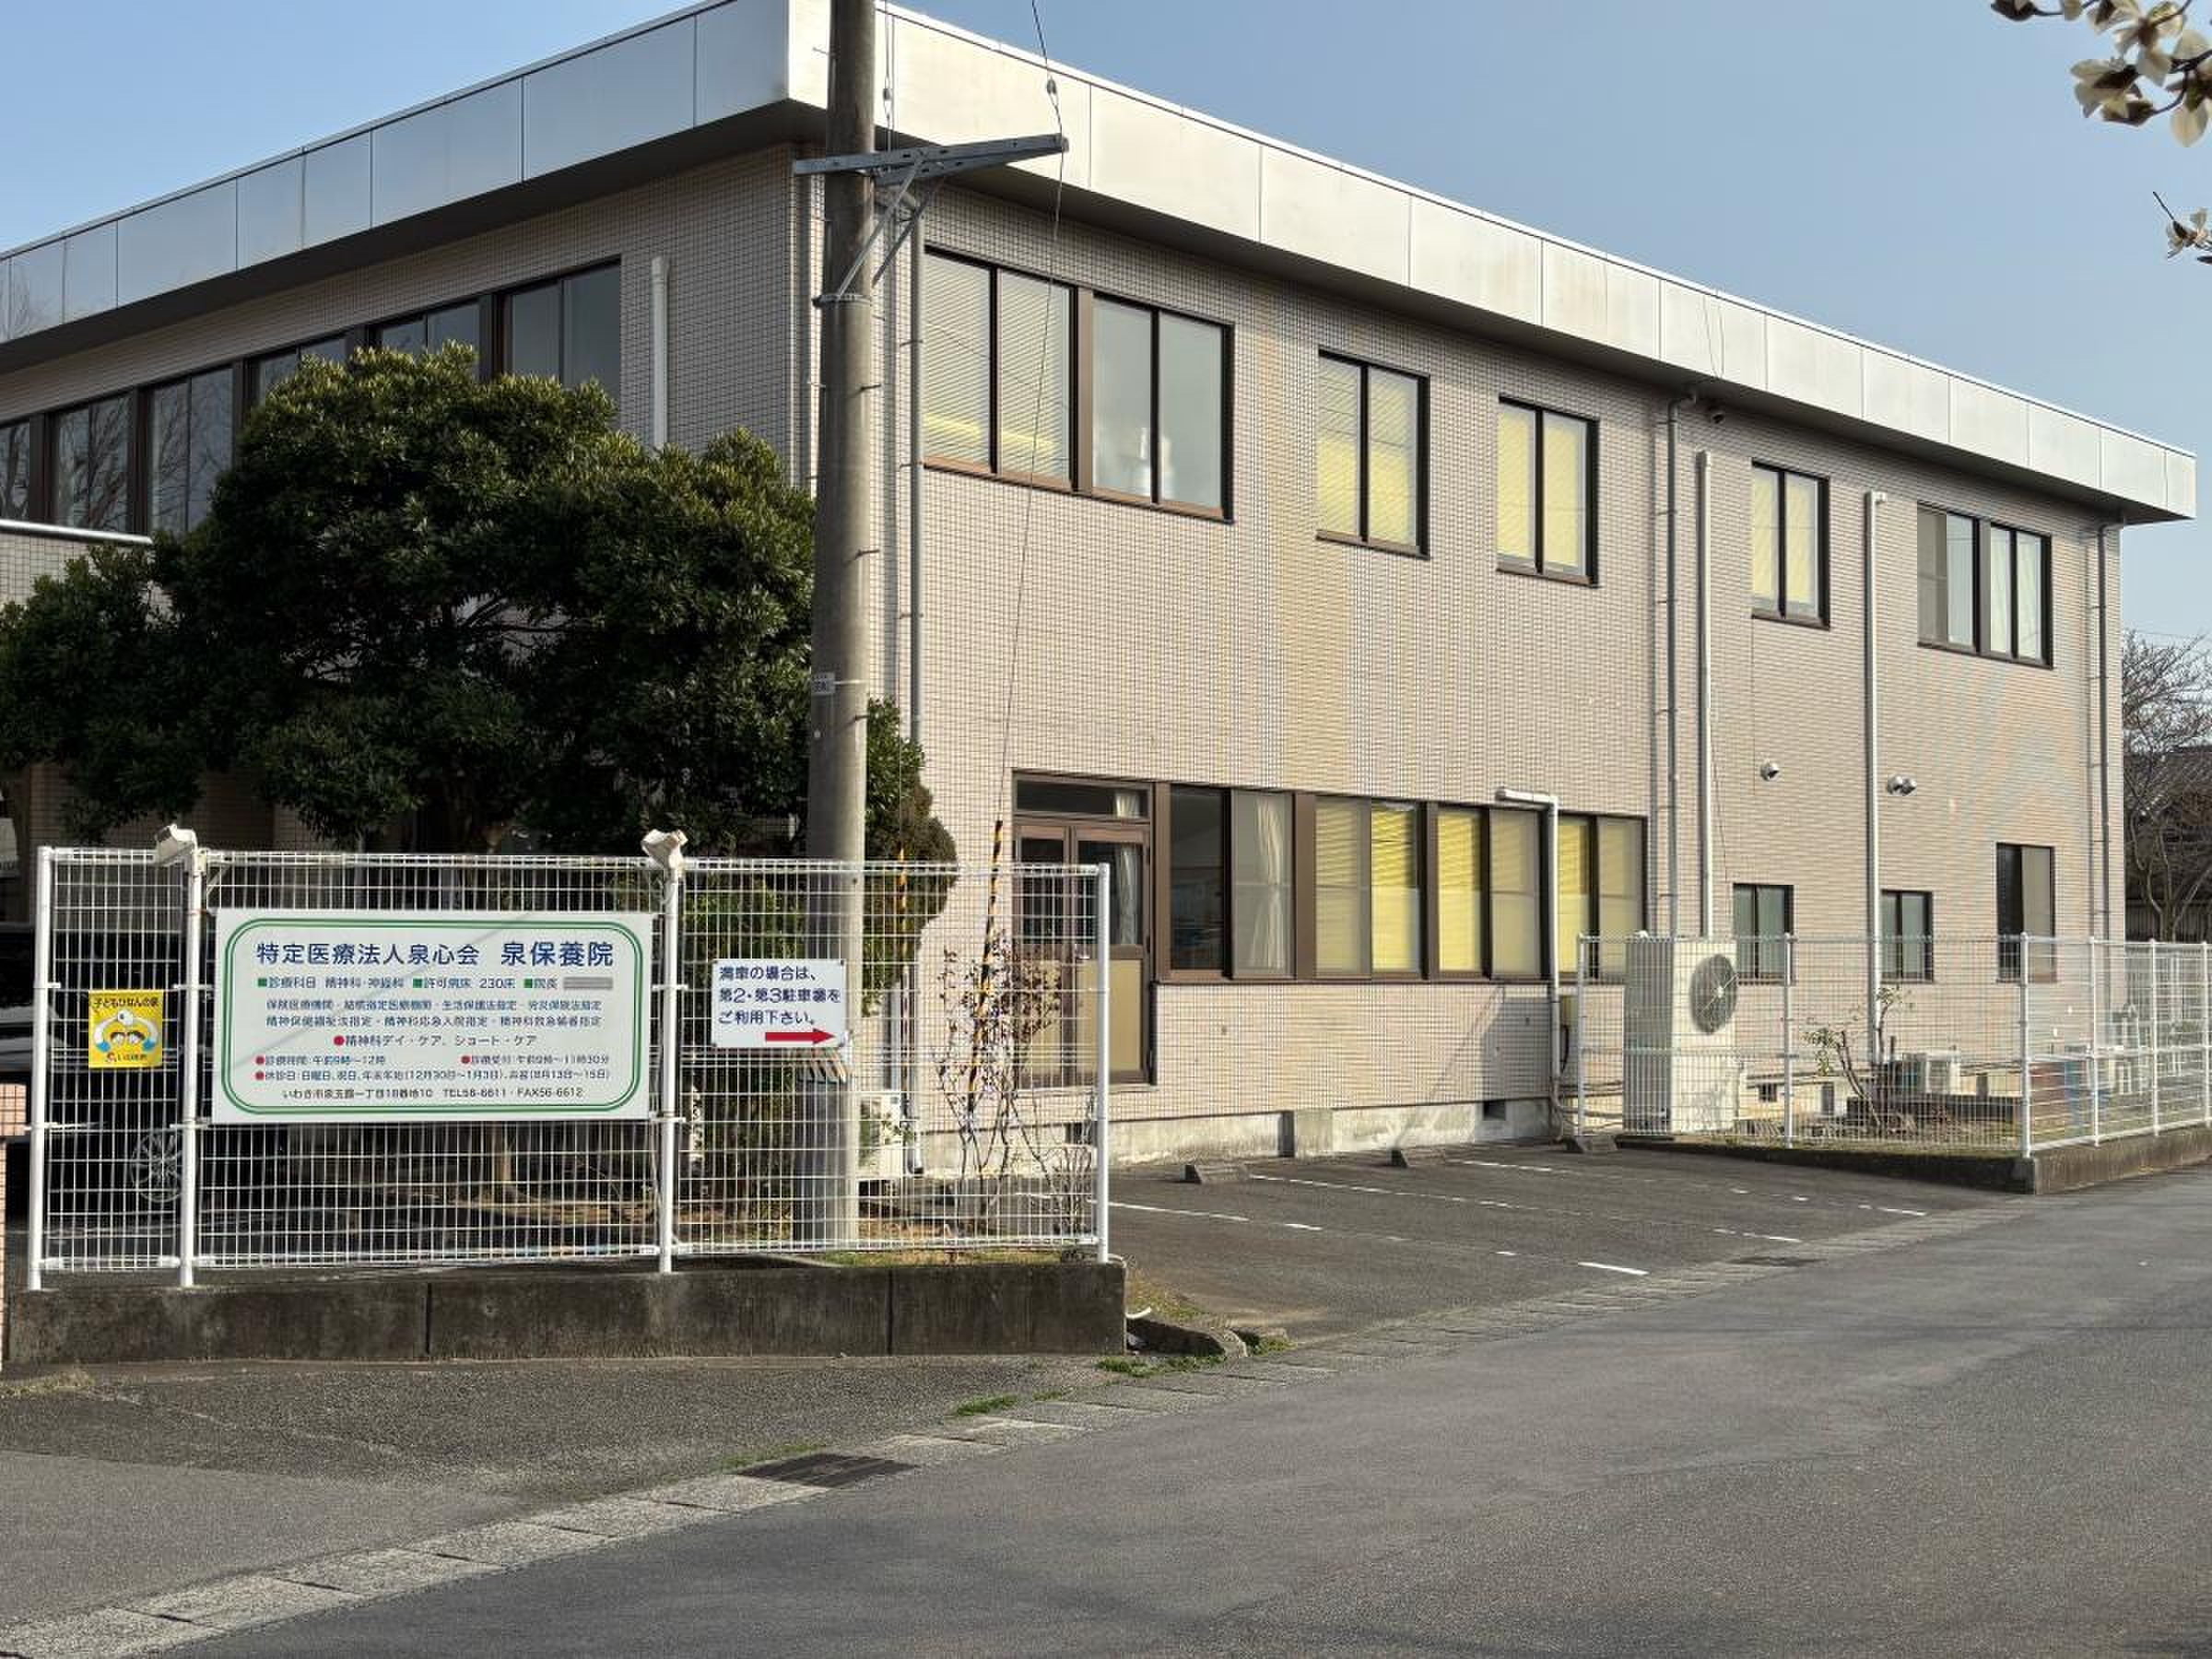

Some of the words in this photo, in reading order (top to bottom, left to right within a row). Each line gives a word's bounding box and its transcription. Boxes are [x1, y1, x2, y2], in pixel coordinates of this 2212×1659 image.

[256, 942, 480, 966] 特定医療法人泉心会
[500, 941, 614, 967] 泉保養院
